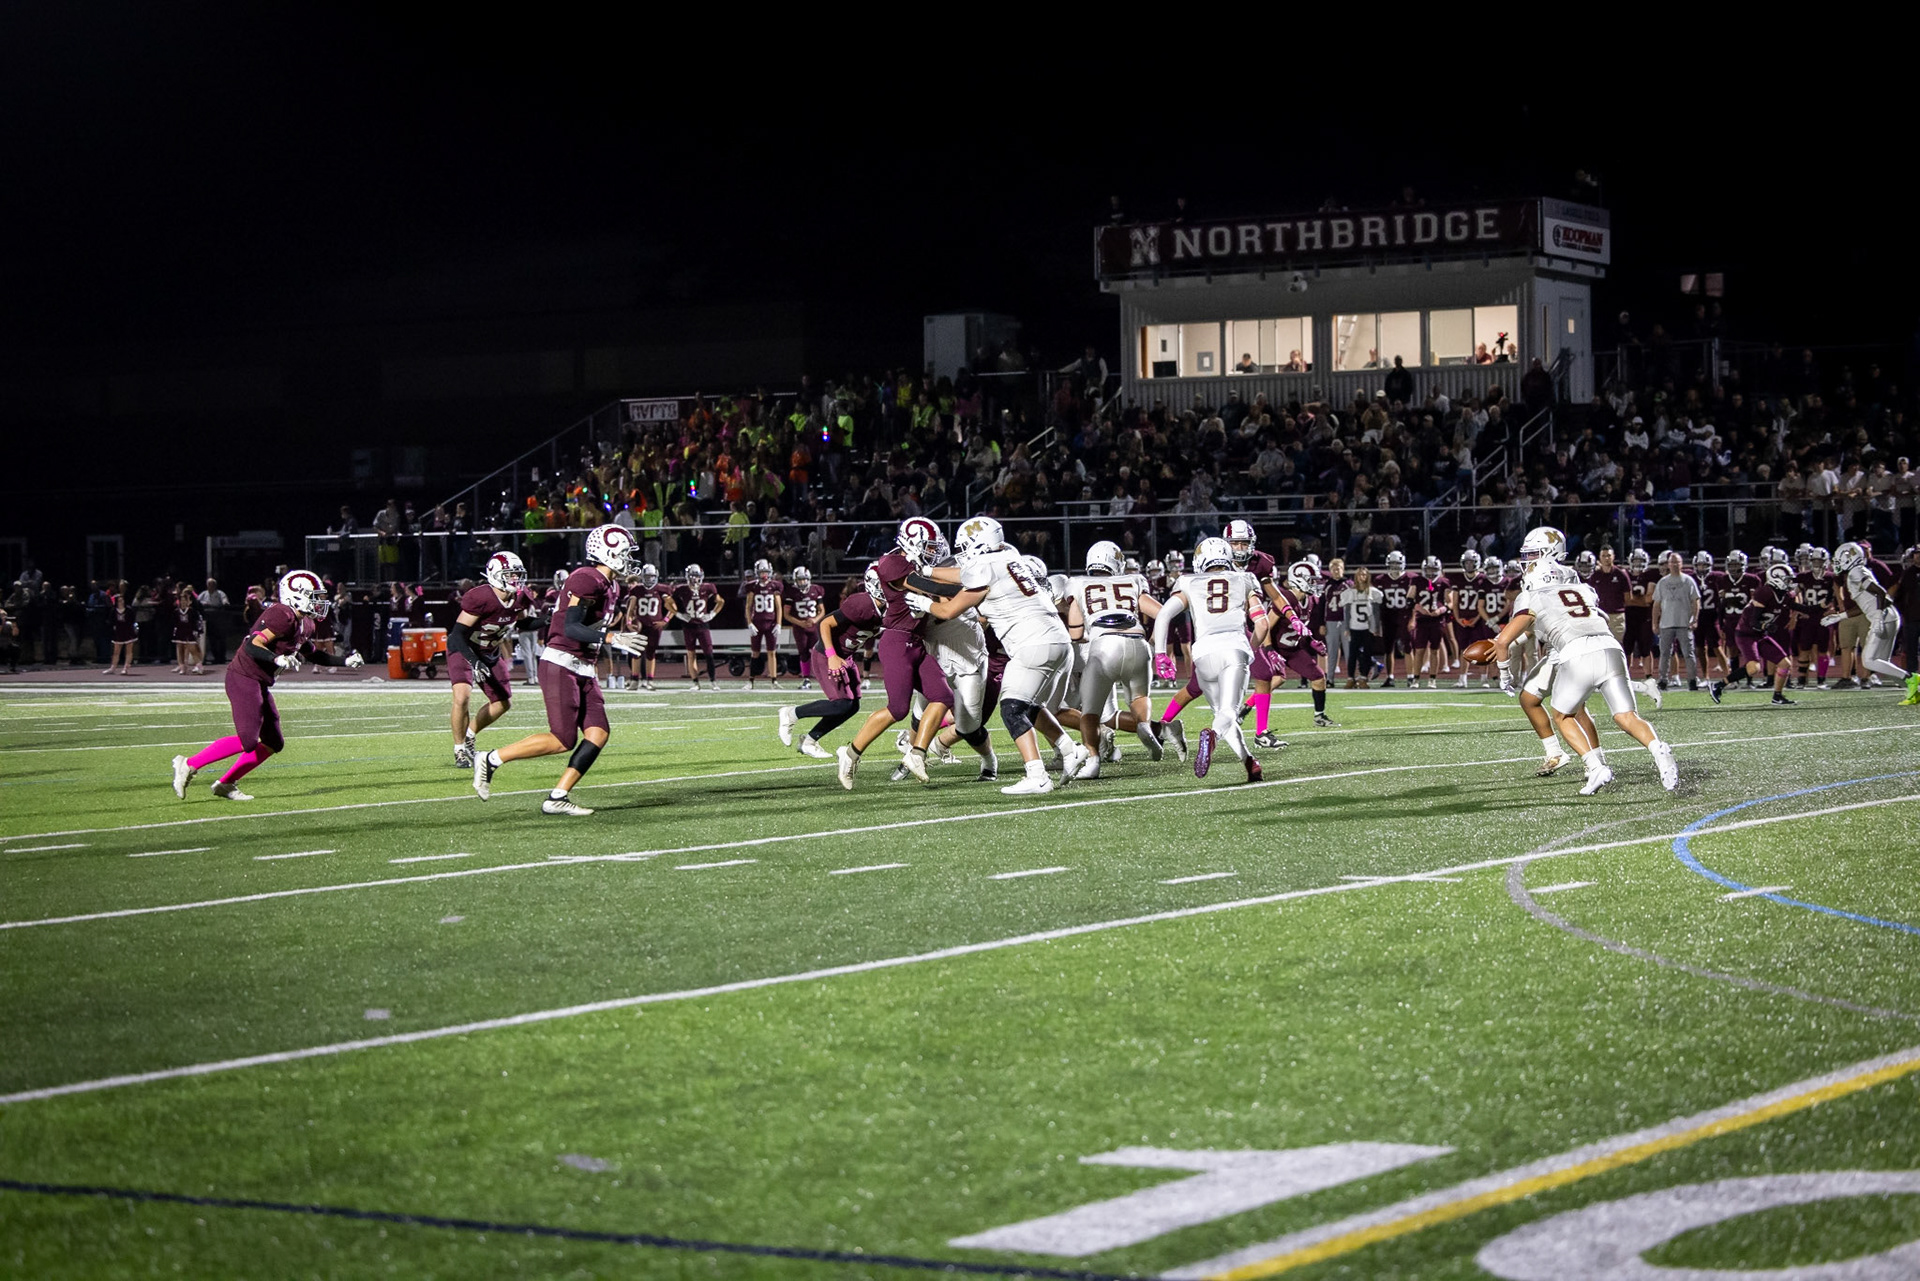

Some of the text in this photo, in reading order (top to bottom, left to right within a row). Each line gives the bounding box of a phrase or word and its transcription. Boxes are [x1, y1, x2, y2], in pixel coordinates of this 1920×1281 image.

[1173, 208, 1500, 259] NORTHBRIDGE
[755, 594, 775, 613] 80
[1085, 583, 1136, 615] 65
[1207, 578, 1229, 614] 8
[1384, 588, 1407, 609] 56
[1418, 590, 1440, 610] 21
[1459, 589, 1479, 610] 37
[1485, 592, 1507, 613] 85
[1557, 589, 1590, 618] 9
[638, 597, 659, 617] 60
[686, 599, 706, 619] 42
[795, 600, 817, 618] 53
[1356, 604, 1368, 623] 5
